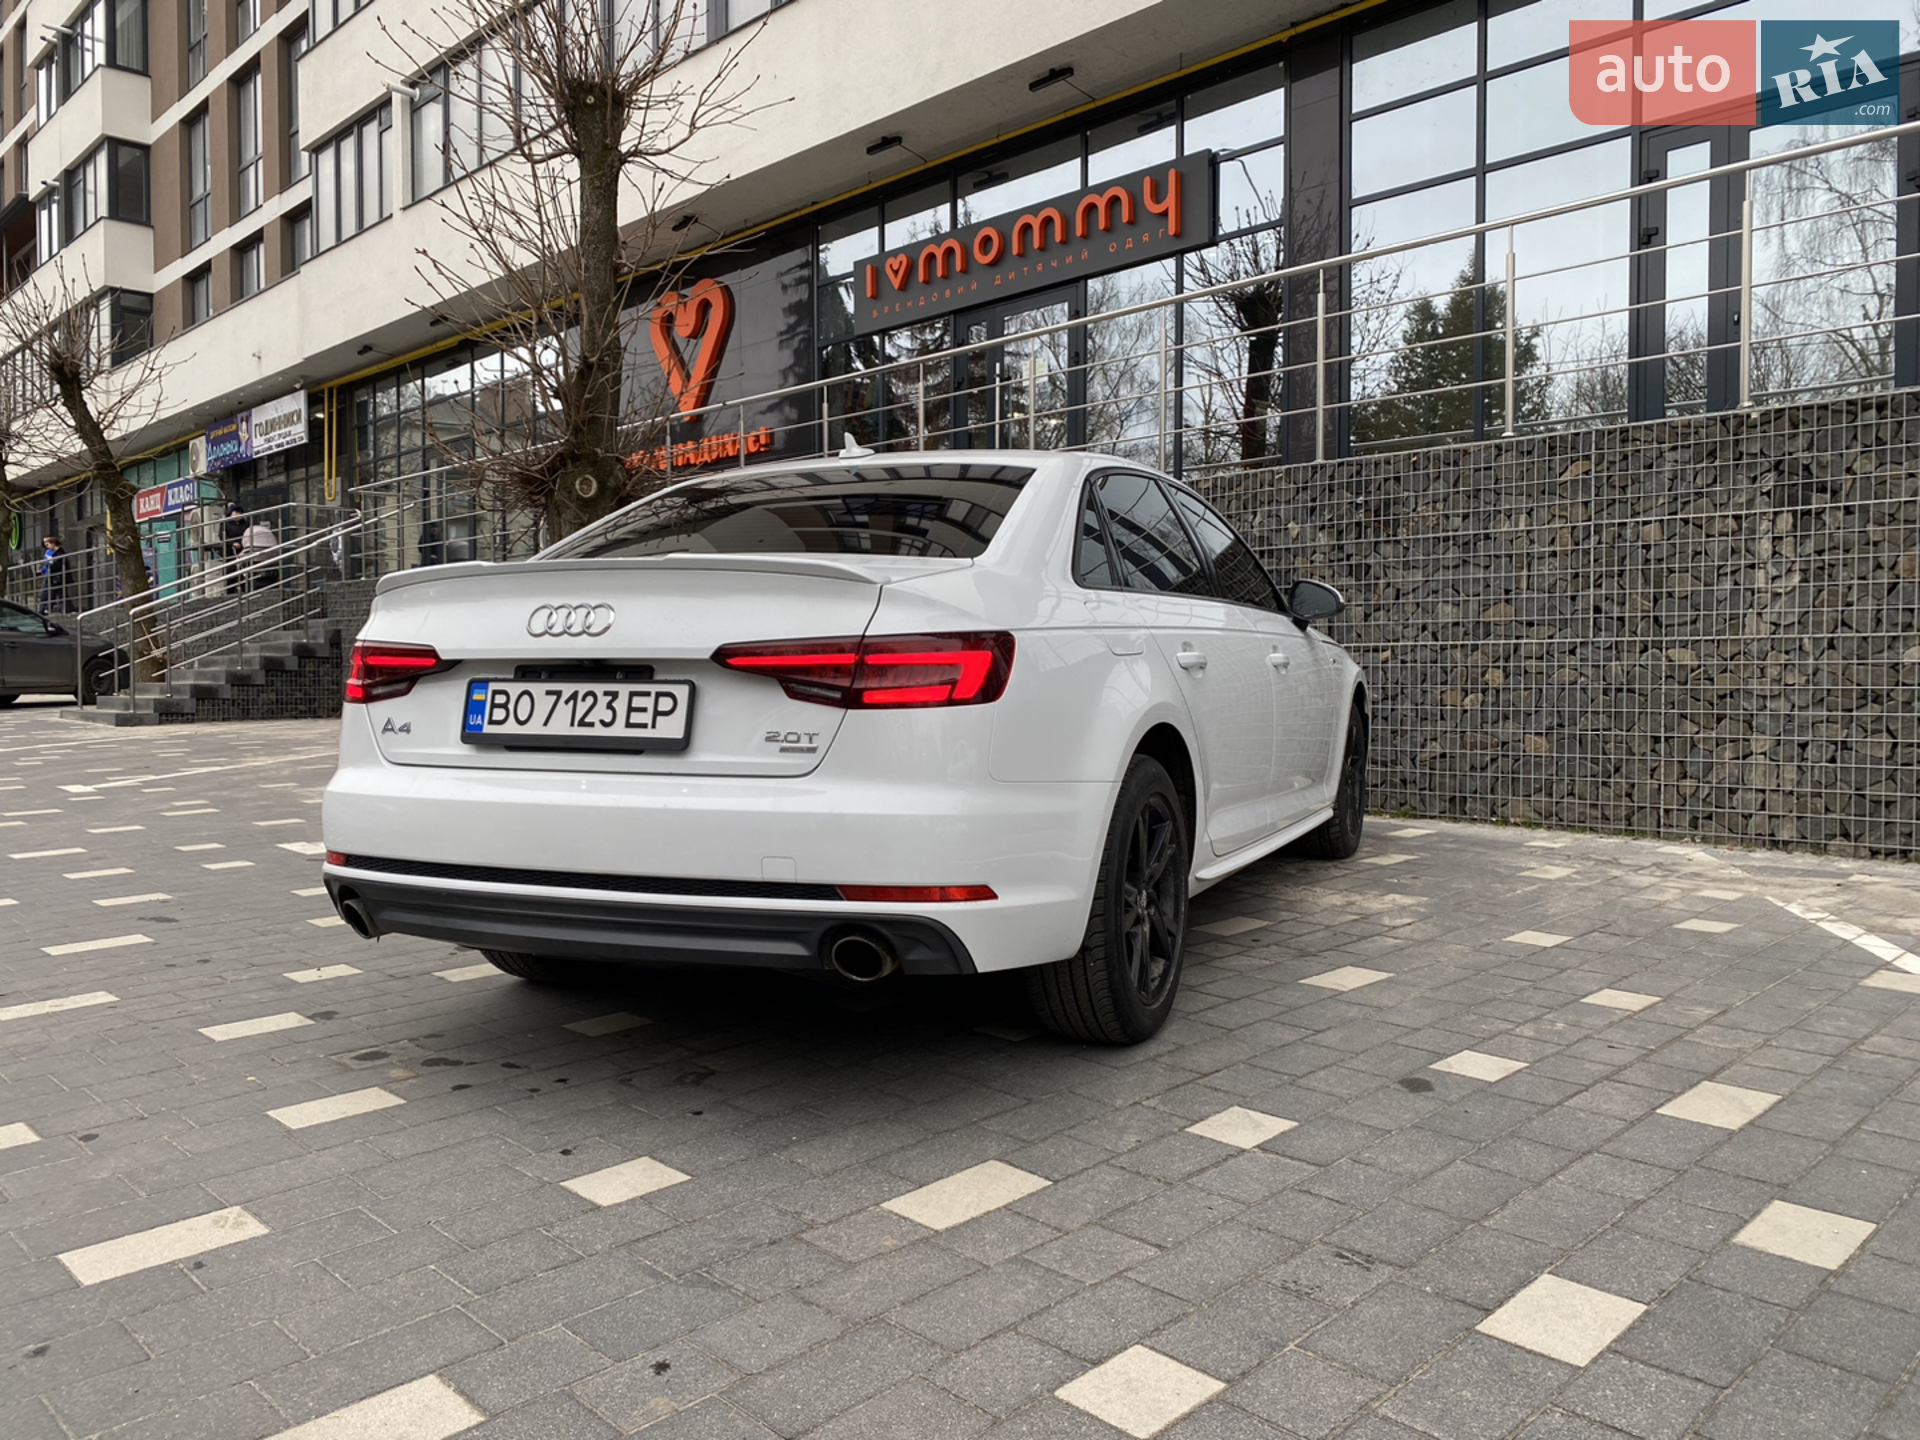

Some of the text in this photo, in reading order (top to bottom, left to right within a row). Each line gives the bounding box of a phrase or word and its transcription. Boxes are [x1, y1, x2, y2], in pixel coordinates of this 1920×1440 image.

[918, 167, 1182, 284] mommy
[872, 228, 1165, 318] БРЕНДОВИЙ ДИТЯЧИЙ ОДЯГ
[469, 714, 483, 726] UA
[487, 689, 678, 729] BO 7123 EP
[381, 716, 412, 735] A4
[765, 731, 820, 744] 2.0T
